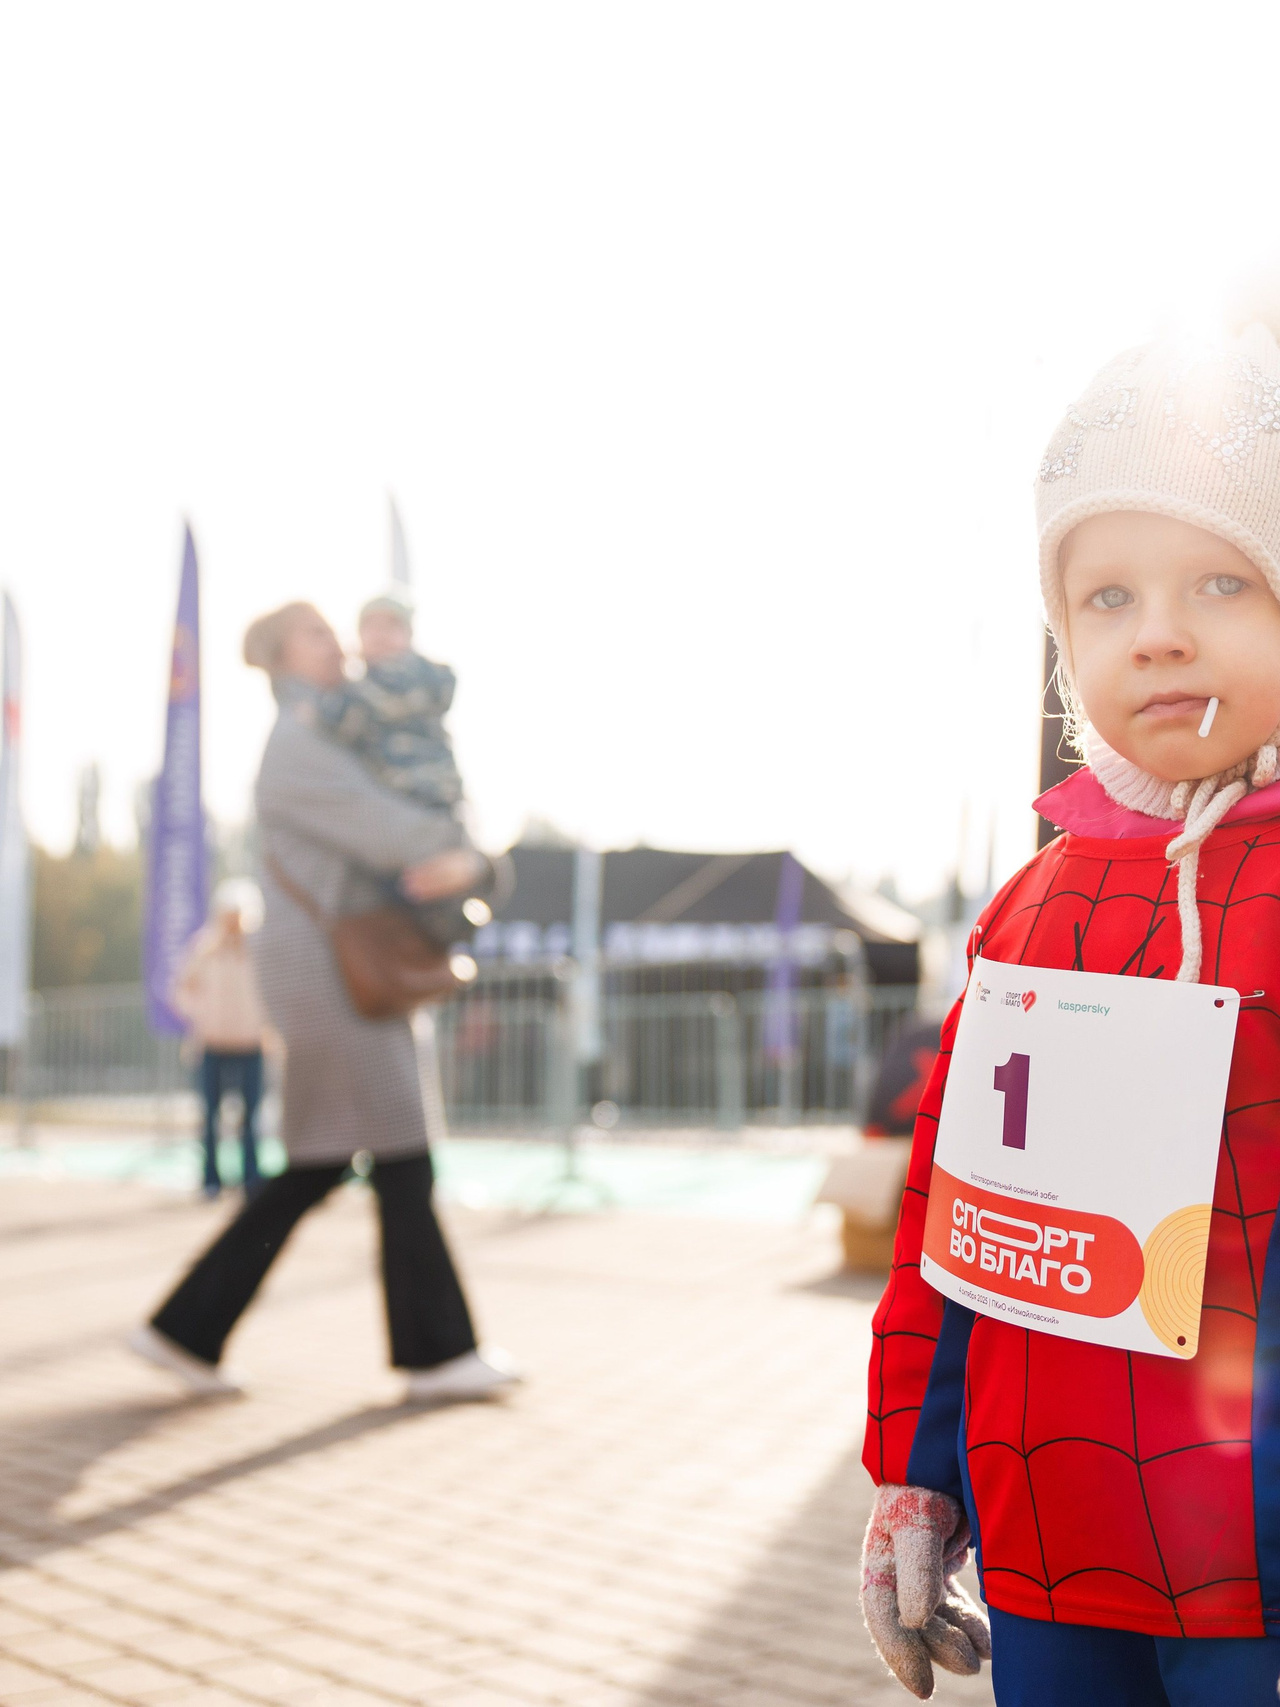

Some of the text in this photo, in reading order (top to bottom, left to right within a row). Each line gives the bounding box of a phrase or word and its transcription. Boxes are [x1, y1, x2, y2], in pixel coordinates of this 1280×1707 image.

[1005, 991, 1021, 1000] СПОРТ
[1005, 999, 1021, 1008] БЛАГО
[1058, 1000, 1111, 1016] kaspersky
[994, 1052, 1031, 1151] 1
[1013, 1184, 1039, 1197] осенний
[1040, 1191, 1059, 1201] забег
[952, 1198, 1095, 1261] СПОРТ
[950, 1228, 1092, 1295] ВО БЛАГО
[977, 1293, 988, 1305] 2025
[991, 1299, 1007, 1312] ПКиО
[1007, 1304, 1060, 1325] «Измайловский»
